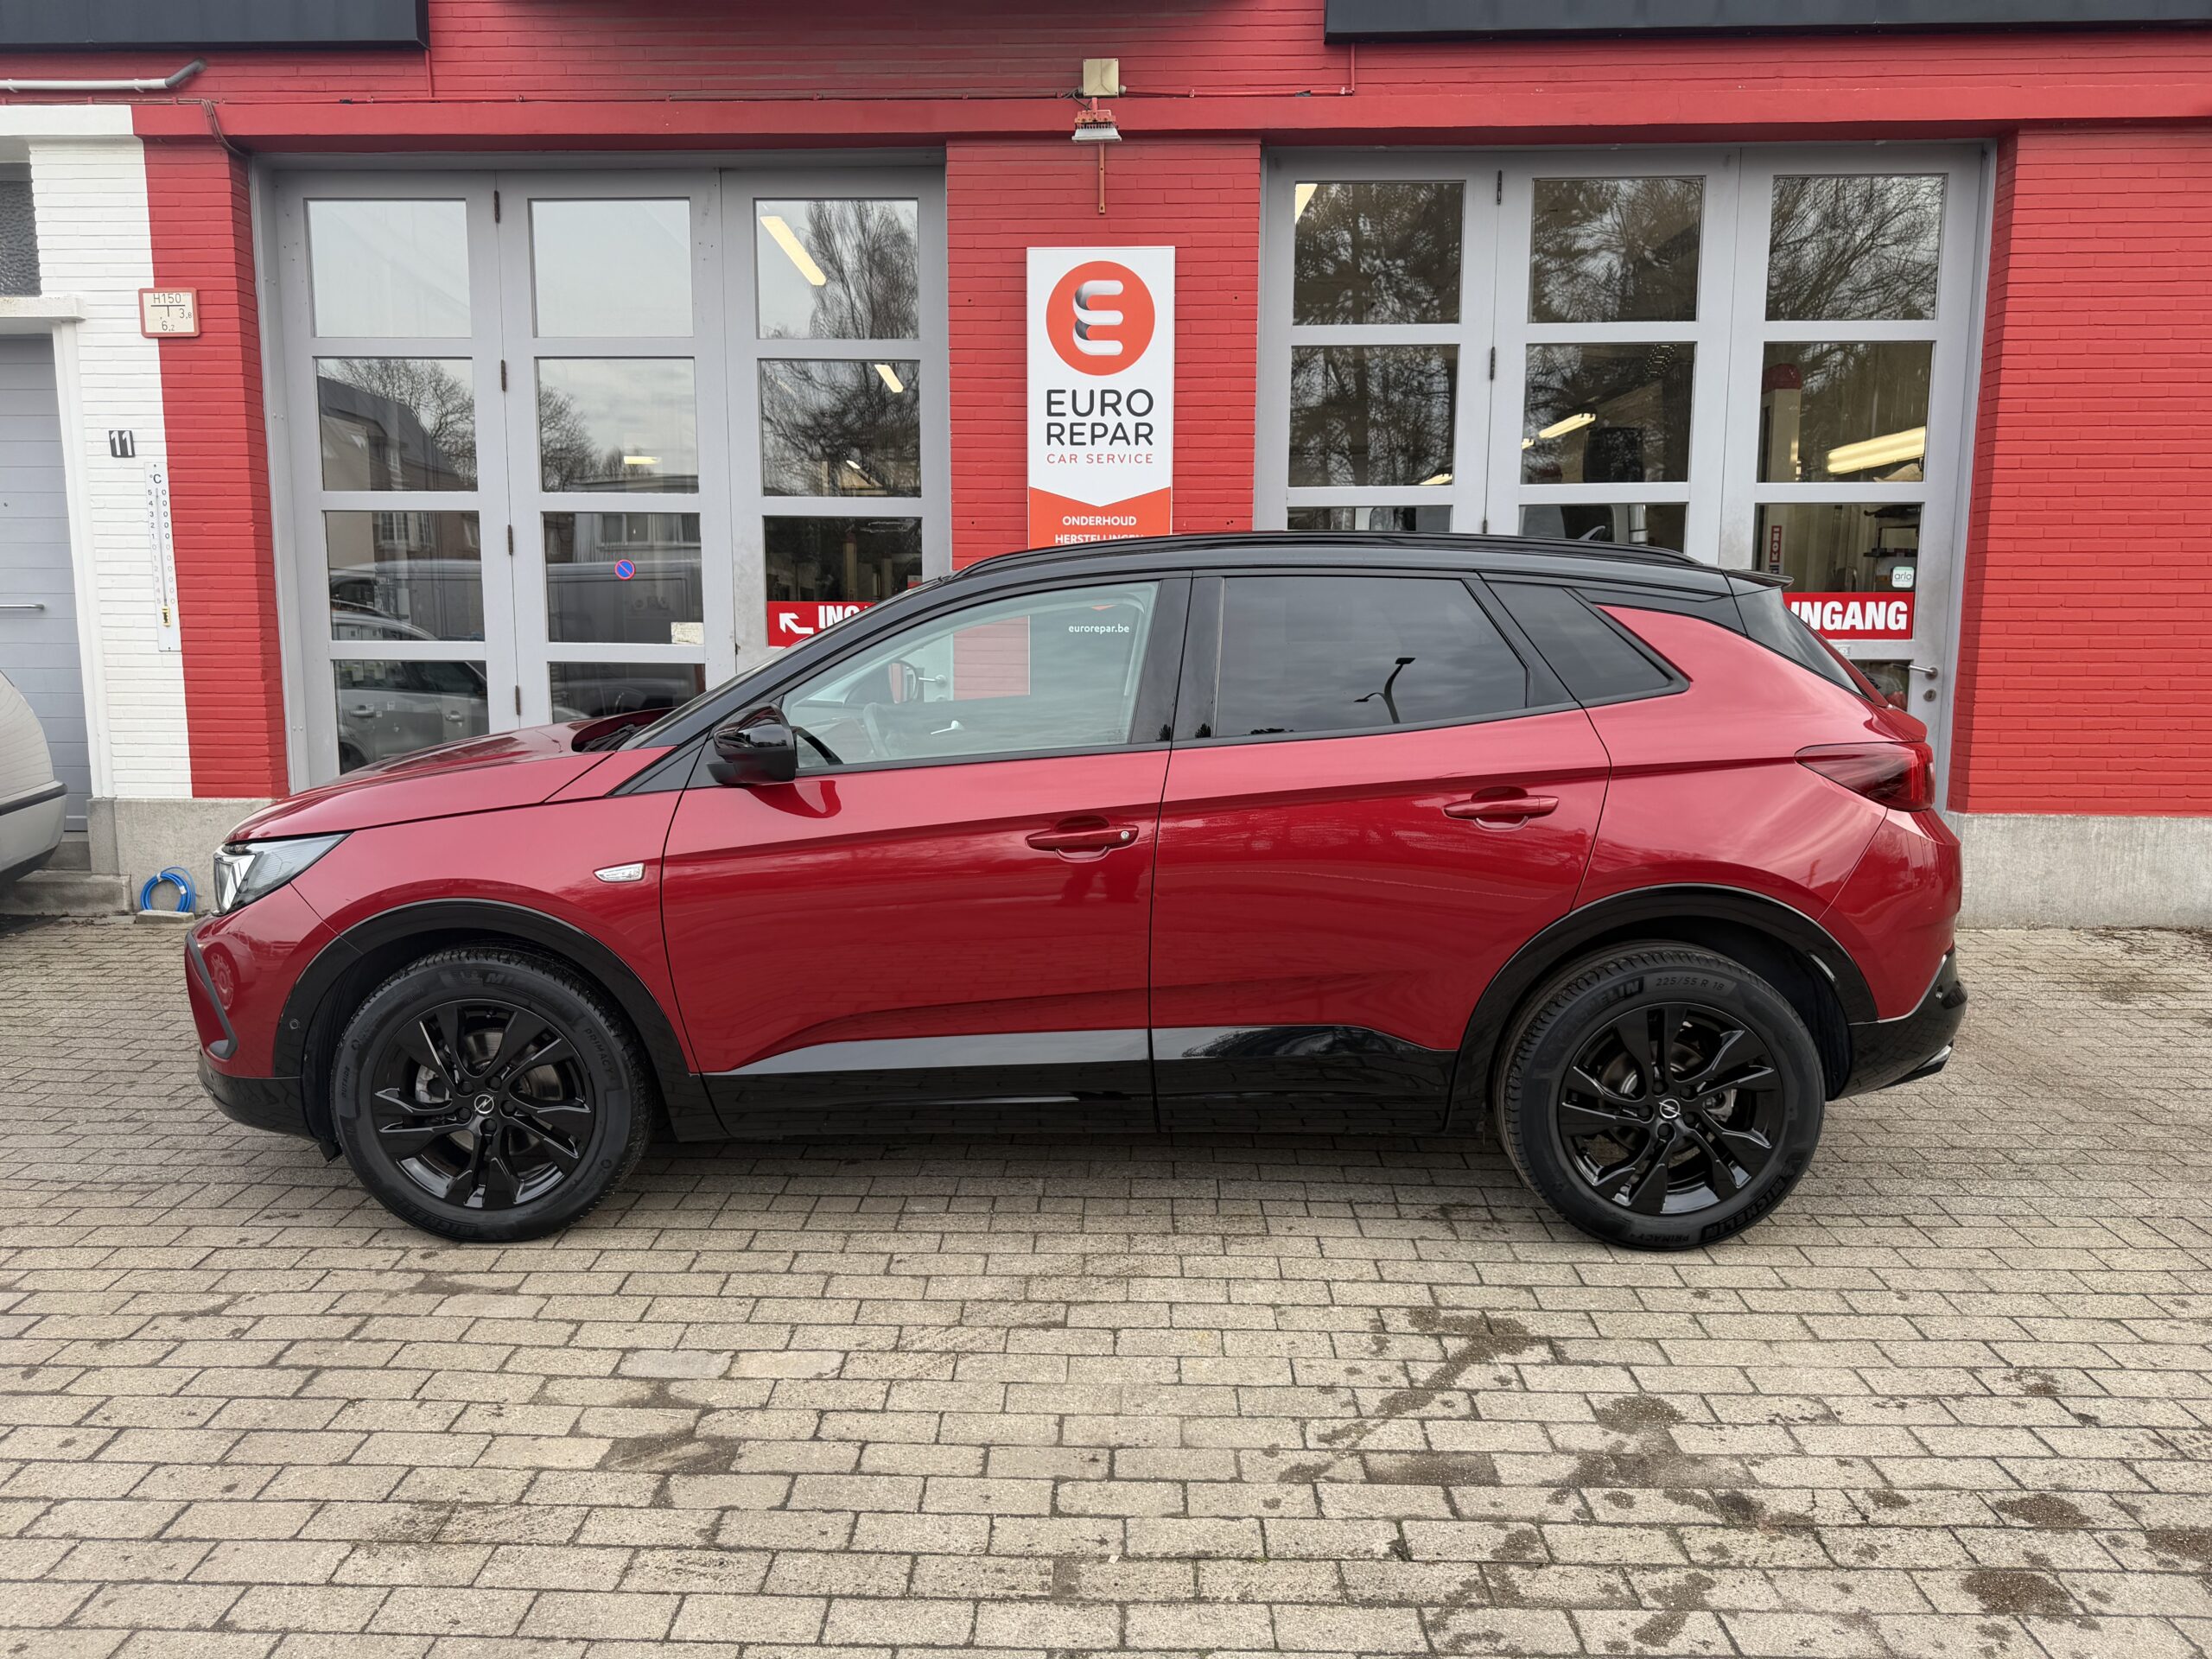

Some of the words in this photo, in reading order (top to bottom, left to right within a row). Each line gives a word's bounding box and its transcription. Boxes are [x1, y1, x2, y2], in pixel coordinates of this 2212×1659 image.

[153, 293, 181, 304] H150
[162, 320, 175, 332] 6,2
[1046, 389, 1154, 417] EURO
[1046, 422, 1154, 446] REPAR
[111, 430, 133, 456] 11
[1046, 454, 1077, 464] CAR
[1086, 454, 1154, 464] SERVICE
[1062, 516, 1137, 526] ONDERHOUD
[1055, 534, 1144, 544] HERSTELLIN
[1771, 527, 1780, 561] KONI
[1894, 572, 1912, 581] arlo
[817, 605, 869, 629] IN
[1068, 623, 1129, 635] eurorepar.be
